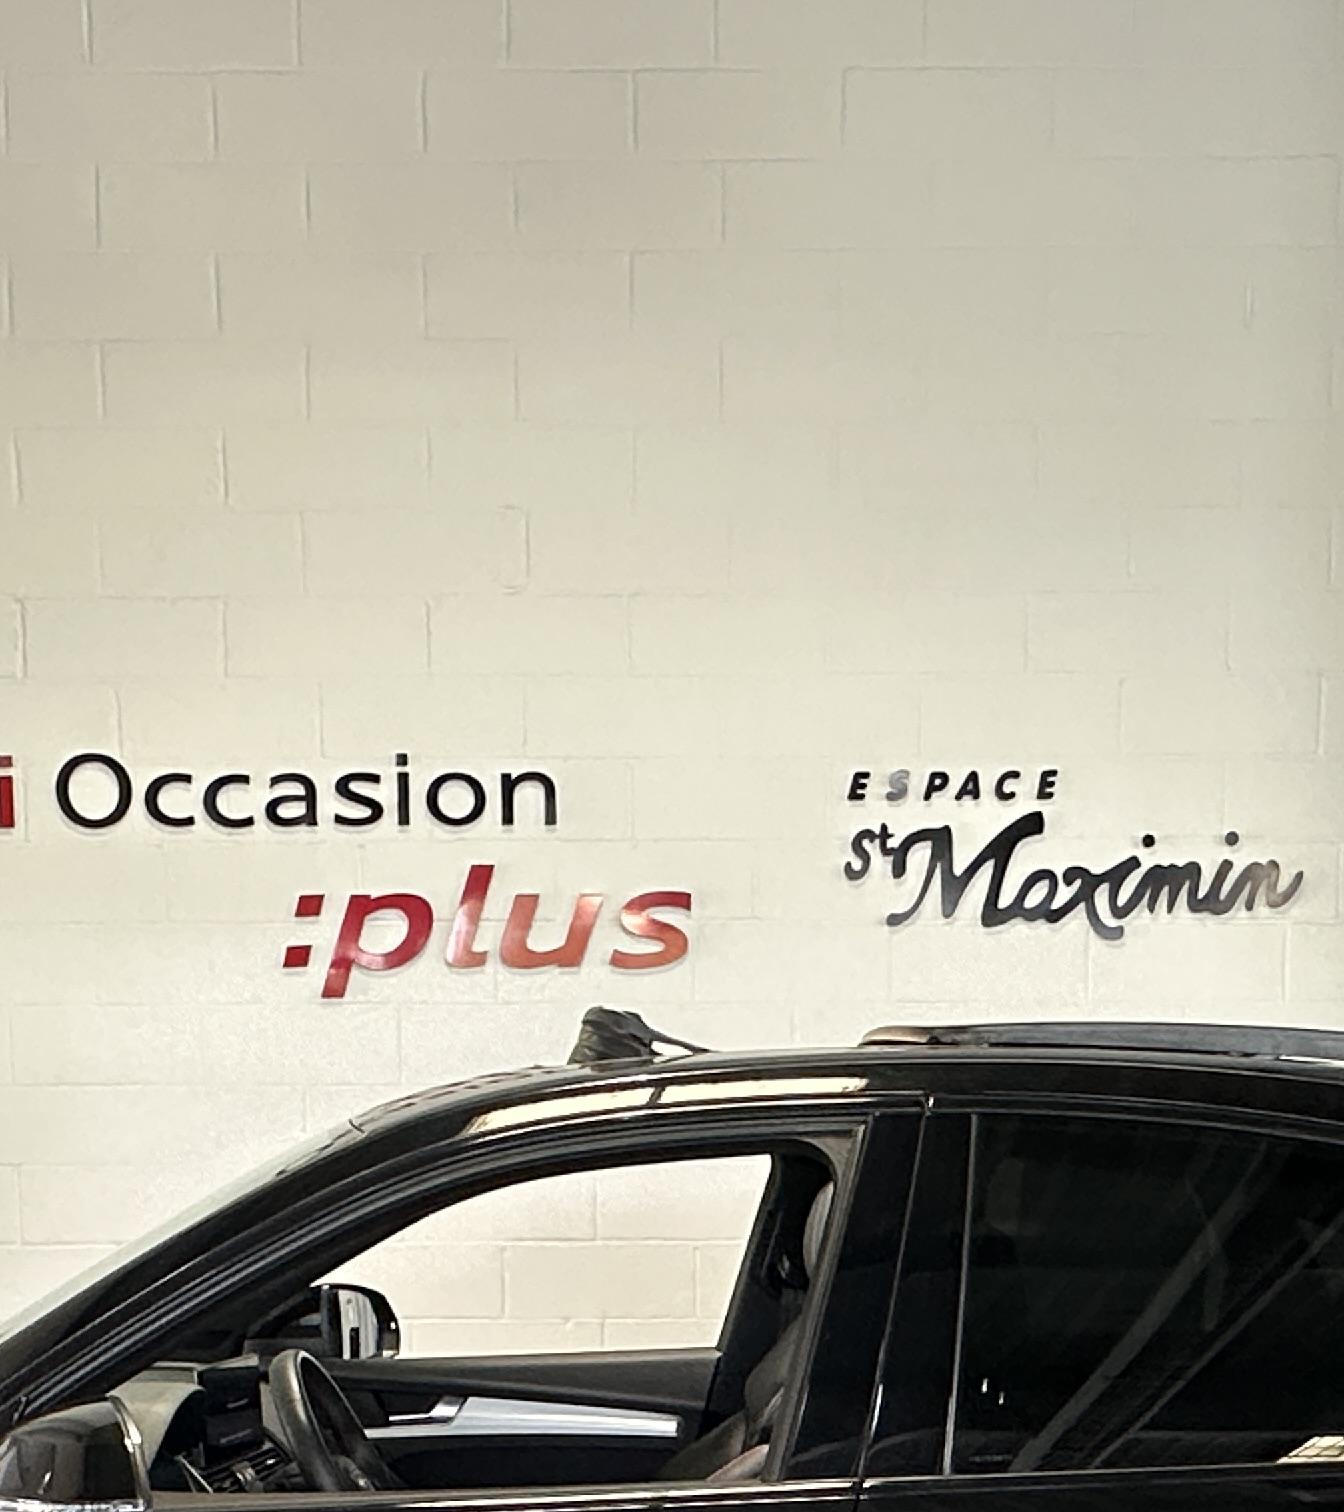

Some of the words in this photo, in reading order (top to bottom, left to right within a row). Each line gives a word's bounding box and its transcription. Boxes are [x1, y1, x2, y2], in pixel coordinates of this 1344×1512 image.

[55, 752, 558, 829] Occasion
[846, 768, 1059, 802] ESPACE
[886, 810, 1305, 940] Maximin
